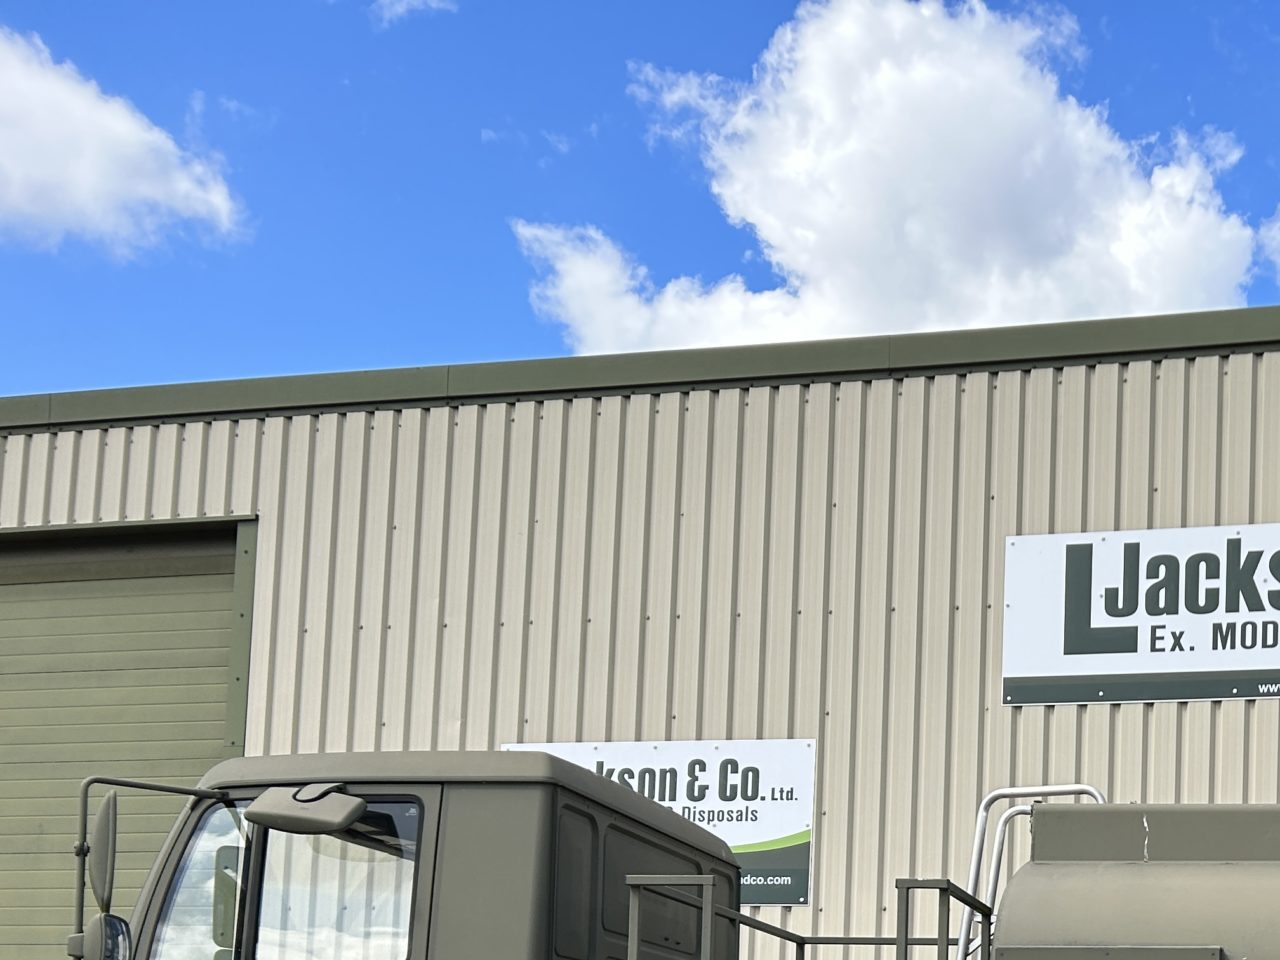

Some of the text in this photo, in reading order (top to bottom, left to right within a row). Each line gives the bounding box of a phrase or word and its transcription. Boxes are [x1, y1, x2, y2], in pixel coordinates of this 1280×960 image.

[1149, 625, 1196, 653] Ex.
[685, 758, 710, 803] &
[718, 758, 766, 802] Co.
[770, 787, 799, 801] Ltd.
[681, 805, 759, 825] Disposals
